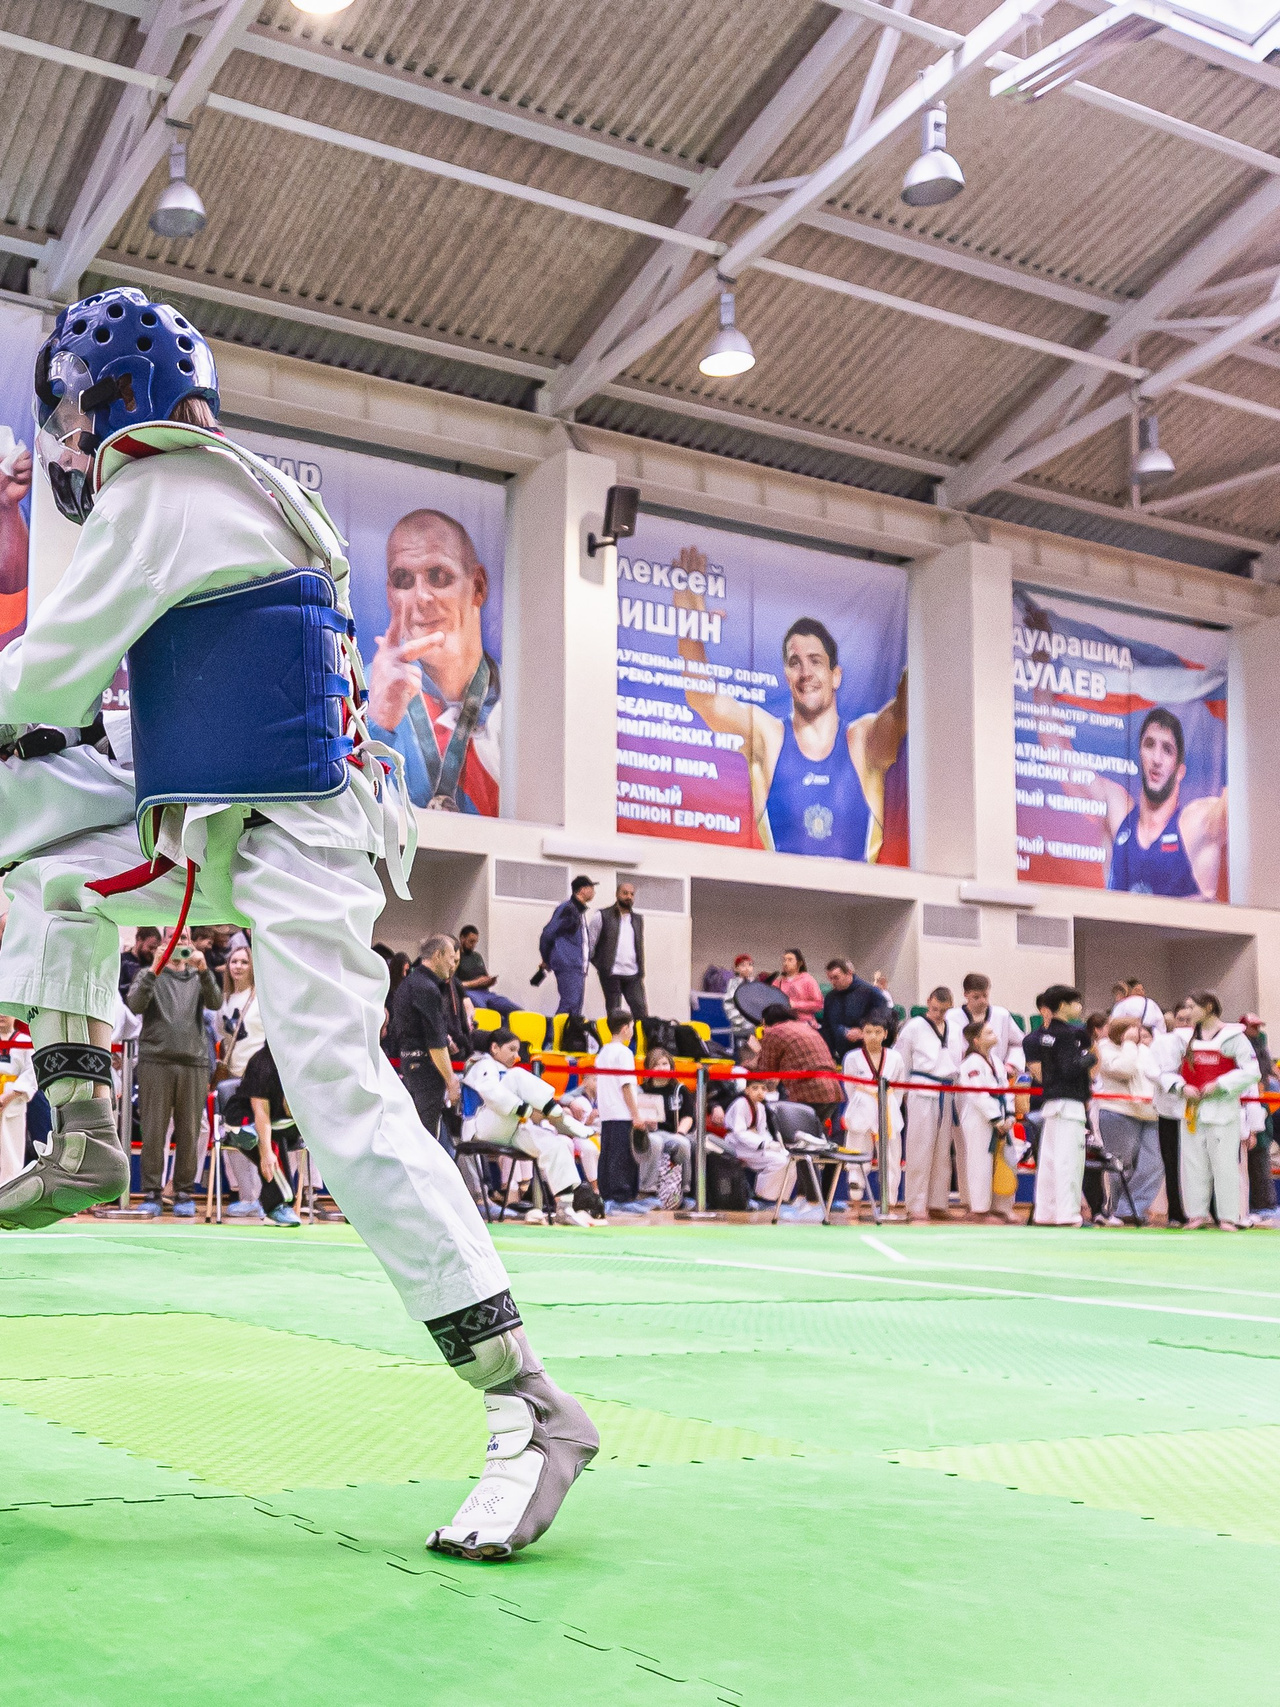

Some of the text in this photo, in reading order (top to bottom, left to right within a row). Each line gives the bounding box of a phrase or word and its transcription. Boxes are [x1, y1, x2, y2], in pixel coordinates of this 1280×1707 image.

[618, 597, 722, 644] ИШИН
[618, 665, 766, 702] РЕКО-РИМСКОЙ БОРЬБЕ
[686, 660, 733, 680] МАСТЕР
[734, 669, 780, 688] СПОРТА
[1038, 720, 1077, 738] БОРЬБЕ
[1089, 714, 1125, 730] СПОРТА
[715, 731, 745, 752] ИГР
[674, 756, 719, 780] МИРА
[1062, 748, 1139, 776] ПОБЕДИТЕЛЬ
[1070, 768, 1096, 786] ИГР
[1046, 793, 1108, 817] ЧЕМПИОН
[617, 802, 741, 834] МПИОН ЕВРОПЫ
[1046, 840, 1107, 863] ЧЕМПИОН
